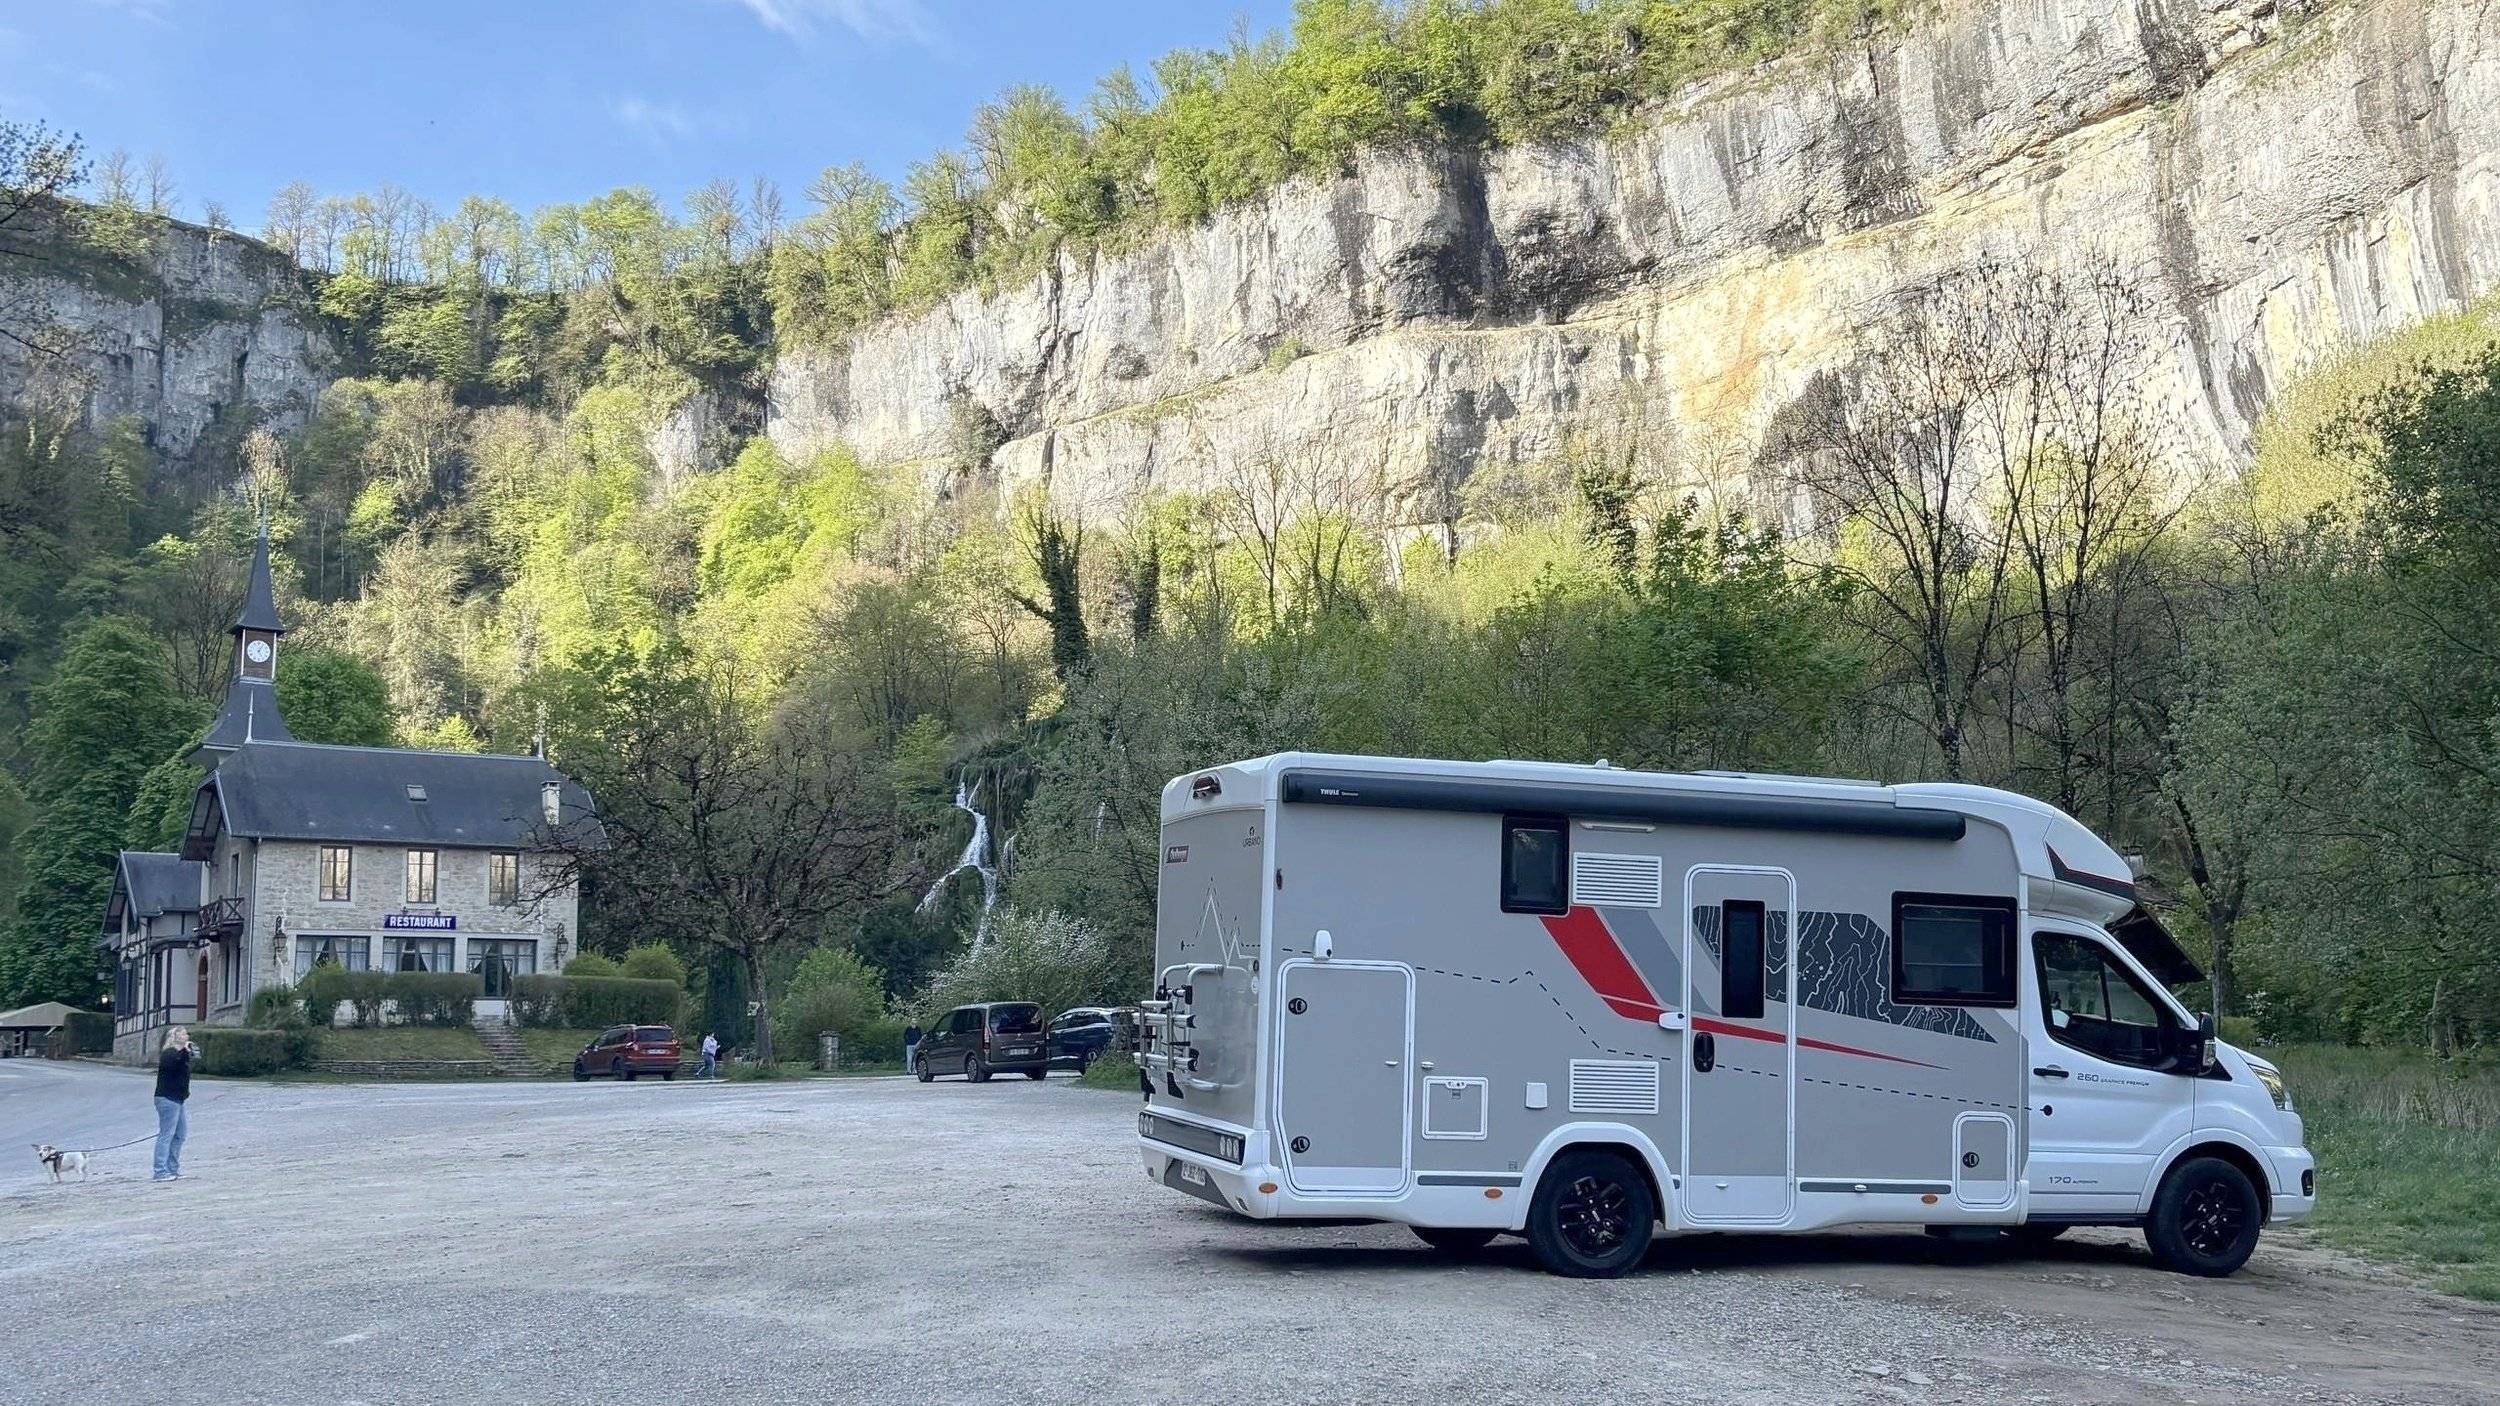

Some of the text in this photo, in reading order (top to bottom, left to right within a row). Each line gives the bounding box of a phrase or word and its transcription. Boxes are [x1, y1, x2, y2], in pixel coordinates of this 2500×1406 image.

[1320, 788, 1340, 796] THULE
[390, 916, 452, 928] RESTAURANT
[2077, 1072, 2099, 1082] 260
[2049, 1176, 2071, 1184] 170
